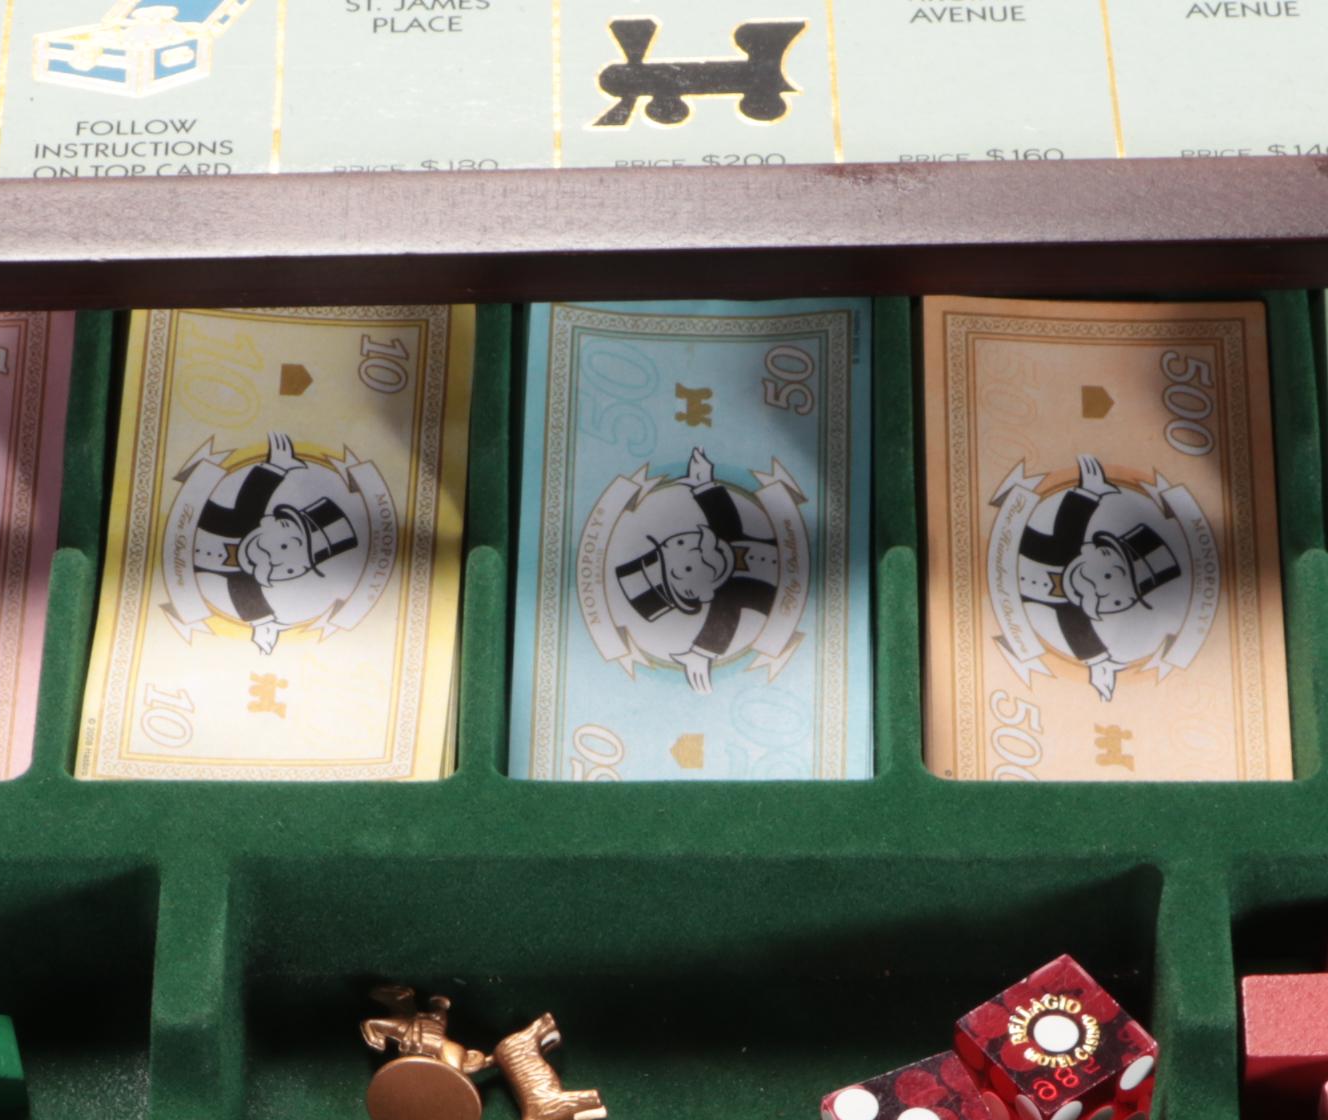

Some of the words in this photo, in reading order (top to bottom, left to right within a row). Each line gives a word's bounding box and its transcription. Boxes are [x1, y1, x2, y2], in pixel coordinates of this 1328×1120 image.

[394, 0, 491, 12] JAMES
[908, 5, 1027, 24] AVENUE
[1185, 0, 1301, 19] AVENUE
[372, 15, 463, 34] PLACE
[75, 118, 197, 136] FOLLOW
[33, 139, 234, 159] INSTRUCTIONS
[33, 164, 79, 178] ON
[89, 163, 146, 177] TOP
[155, 162, 232, 176] CARD
[357, 333, 410, 396] 10
[761, 344, 815, 416] 50
[1160, 349, 1214, 457] 500
[140, 682, 196, 749] 10
[1008, 993, 1082, 1046] BELLAGIO
[1024, 1047, 1077, 1069] HOTEL
[1074, 1013, 1101, 1061] CASINO
